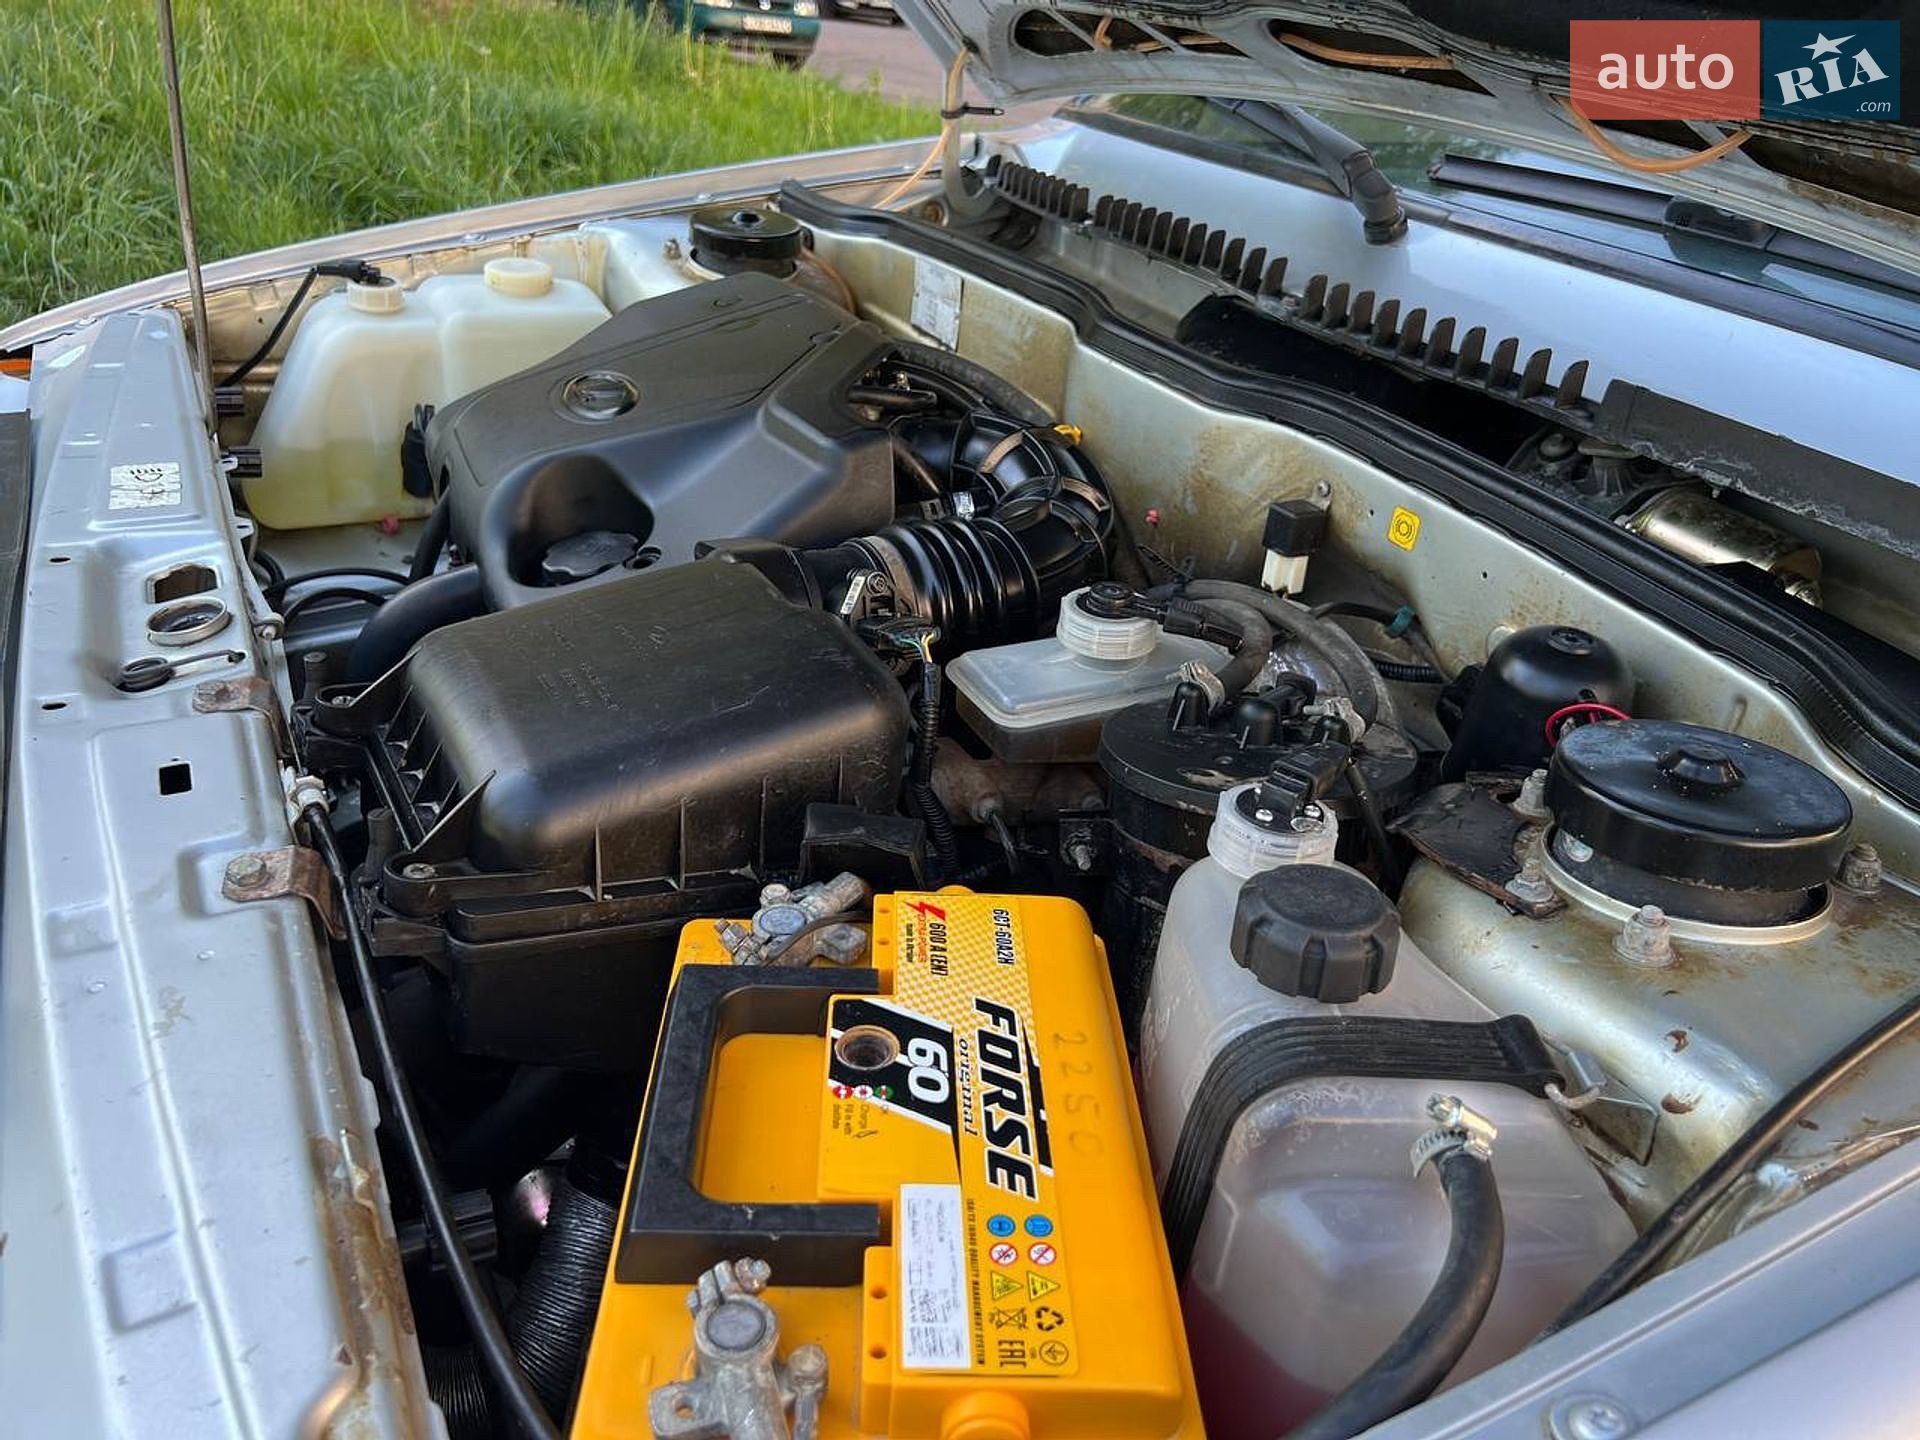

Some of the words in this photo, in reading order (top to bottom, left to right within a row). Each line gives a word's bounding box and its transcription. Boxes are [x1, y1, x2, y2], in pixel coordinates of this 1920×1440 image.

[929, 923, 947, 943] 600
[907, 1038, 951, 1103] 60
[958, 1038, 977, 1137] original
[974, 997, 1036, 1201] FORSE
[998, 1340, 1028, 1368] EAC
